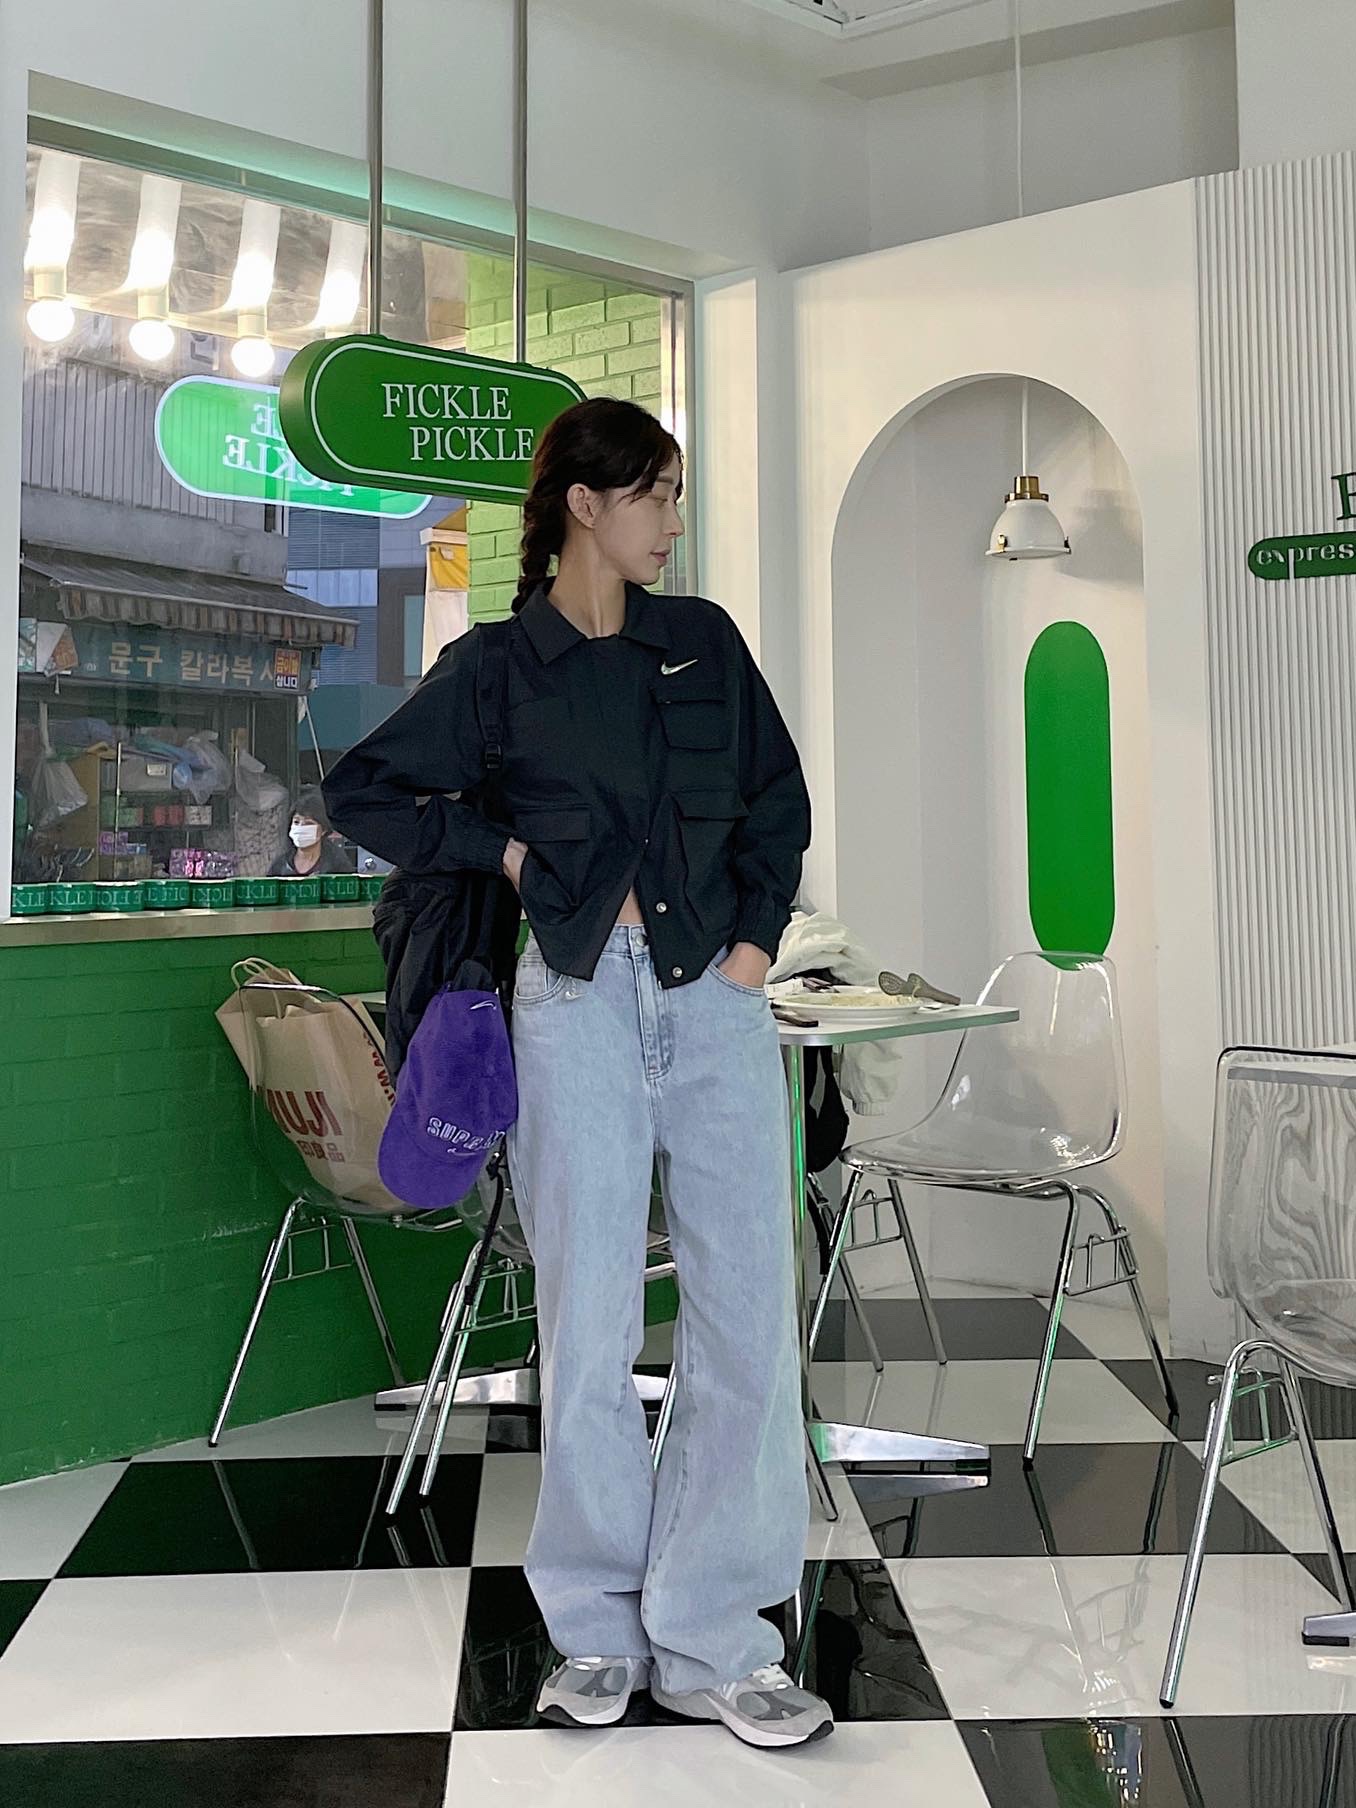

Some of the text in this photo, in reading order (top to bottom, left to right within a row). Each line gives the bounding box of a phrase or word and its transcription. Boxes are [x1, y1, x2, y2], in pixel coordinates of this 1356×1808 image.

[381, 383, 512, 420] FICKLE
[409, 426, 535, 461] PICKLE
[109, 641, 163, 677] 문구
